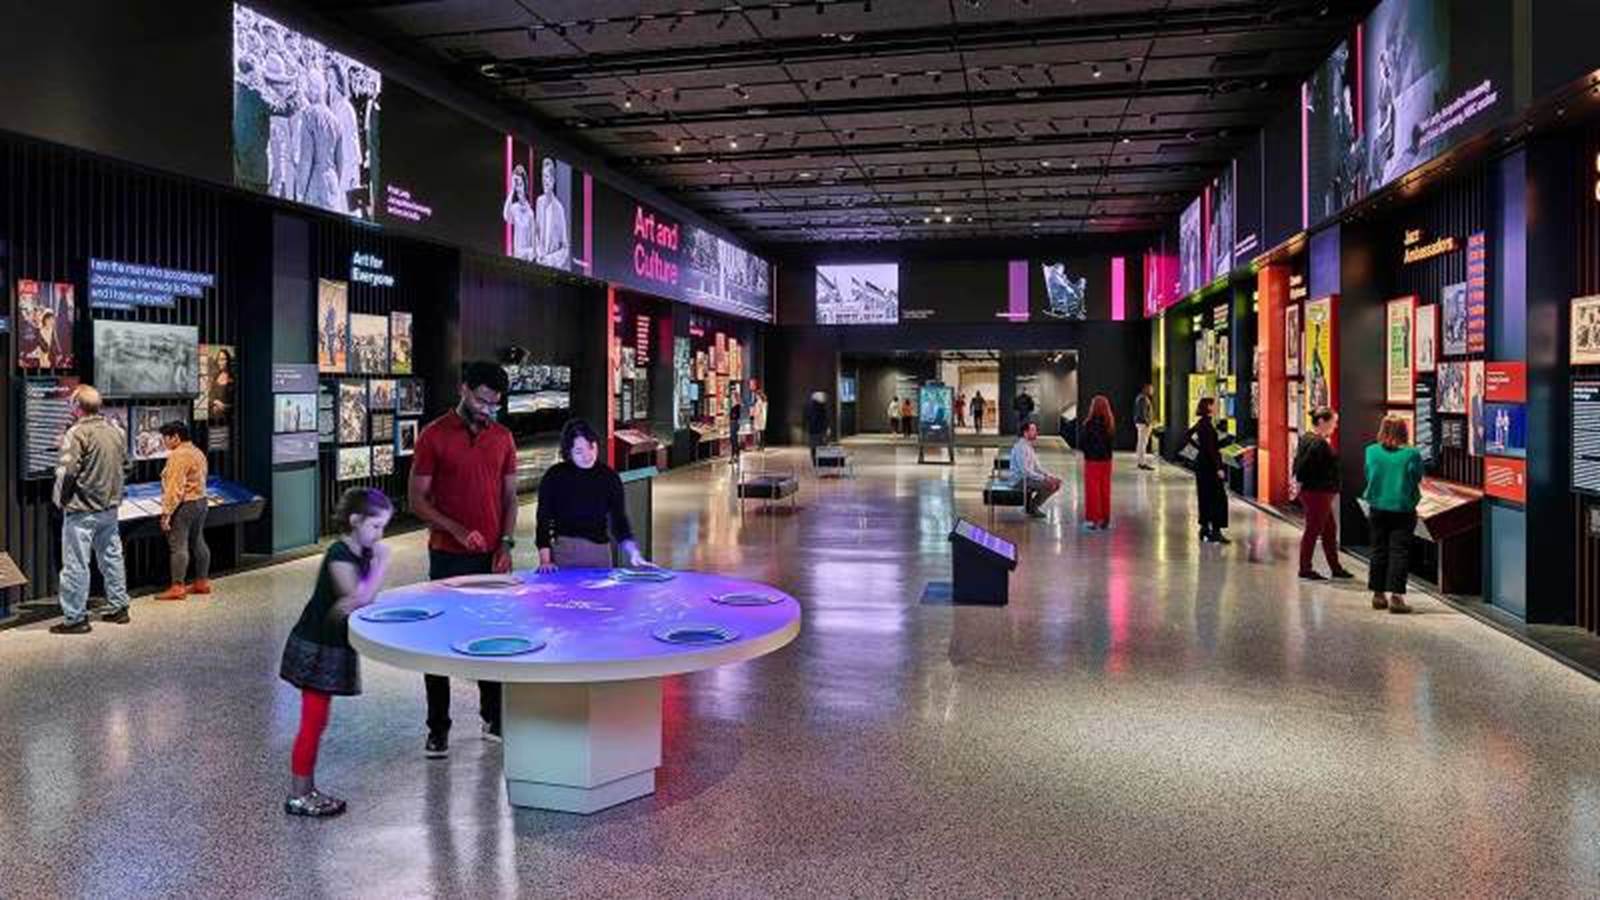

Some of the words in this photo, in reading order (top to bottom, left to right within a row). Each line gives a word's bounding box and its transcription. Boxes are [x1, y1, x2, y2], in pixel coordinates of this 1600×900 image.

[634, 206, 655, 242] Art
[656, 223, 678, 250] and
[353, 252, 369, 266] Art
[369, 255, 383, 269] for
[634, 243, 678, 285] Culture
[353, 267, 394, 287] Everyone
